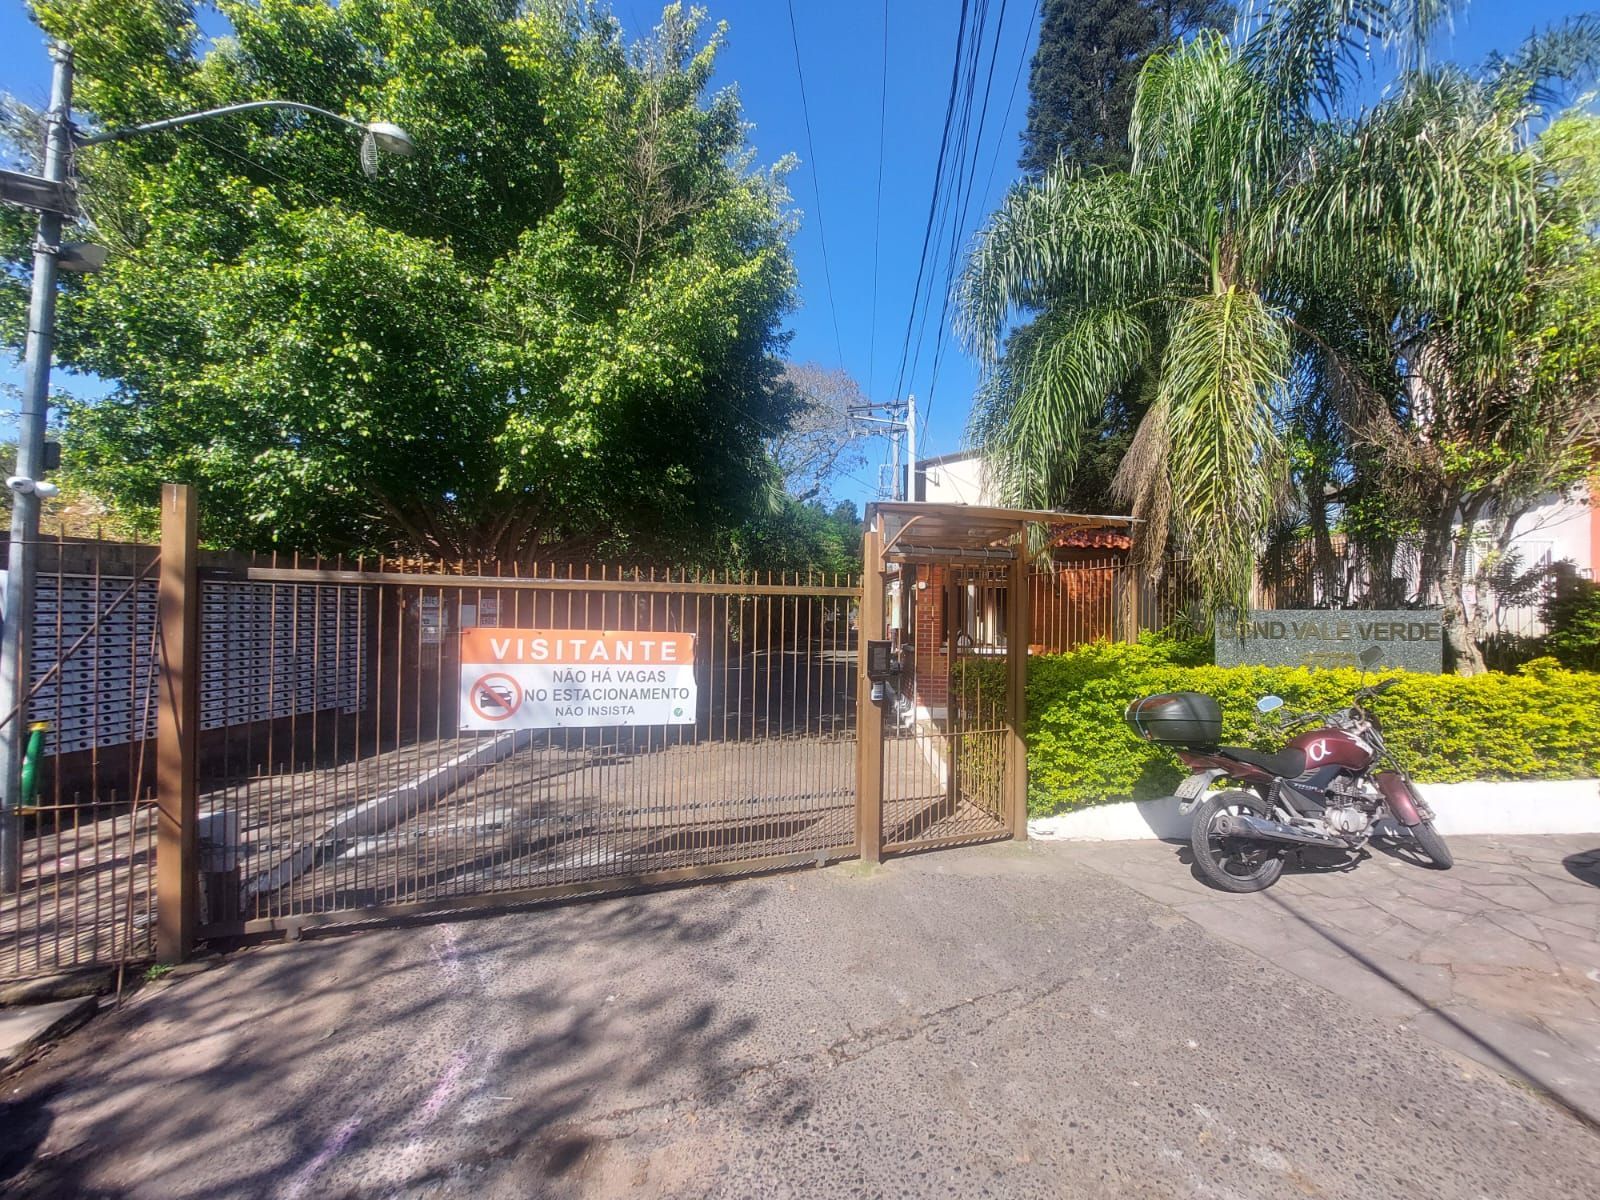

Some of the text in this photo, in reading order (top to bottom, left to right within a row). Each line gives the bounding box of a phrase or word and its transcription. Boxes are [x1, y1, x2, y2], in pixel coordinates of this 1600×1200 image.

[1293, 621, 1352, 641] VALE
[1357, 622, 1441, 642] VERDE
[490, 638, 677, 661] VISITANTE
[553, 667, 666, 683] NÃO HÁ VAGAS
[524, 687, 690, 702] NO ESTACIONAMENTO
[555, 704, 635, 717] NÃO INSISTA
